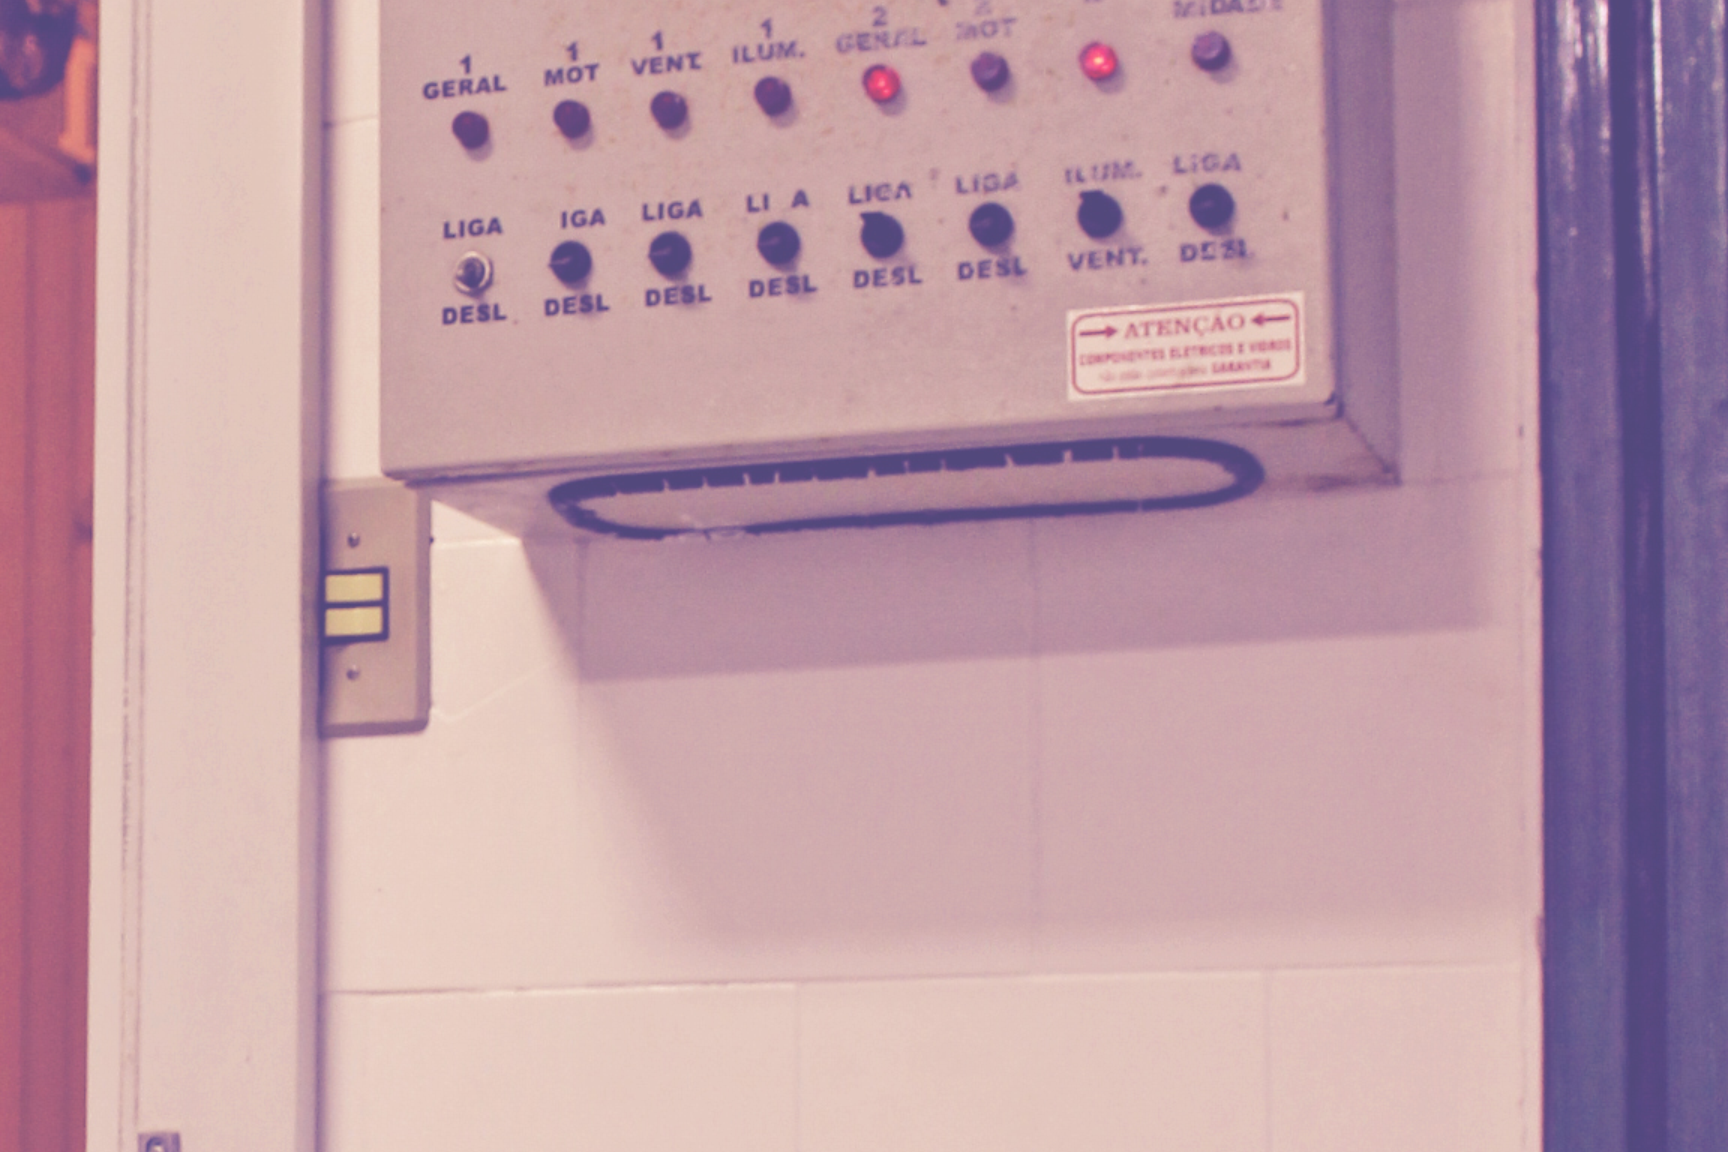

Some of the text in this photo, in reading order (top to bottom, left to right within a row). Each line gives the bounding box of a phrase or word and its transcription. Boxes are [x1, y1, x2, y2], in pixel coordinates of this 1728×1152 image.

[759, 17, 773, 40] 1
[871, 5, 888, 29] 2
[565, 41, 580, 63] 1
[650, 30, 664, 52] 1
[731, 40, 806, 65] ILUM.
[459, 54, 472, 76] 1
[543, 62, 600, 87] MOT
[421, 74, 508, 101] GERAL
[1171, 152, 1243, 176] LIGA
[954, 170, 1020, 196] LIGA
[641, 198, 704, 223] LIGA
[745, 188, 811, 215] LIA
[442, 216, 504, 241] LIGA
[954, 256, 1029, 282] DESL
[1066, 246, 1148, 272] VENT.
[748, 274, 818, 298] DESL
[852, 264, 923, 290] DESL
[543, 294, 610, 316] DESL
[644, 285, 712, 307] DESL
[441, 302, 508, 326] DESL
[1124, 313, 1246, 337] ATENÇÃO
